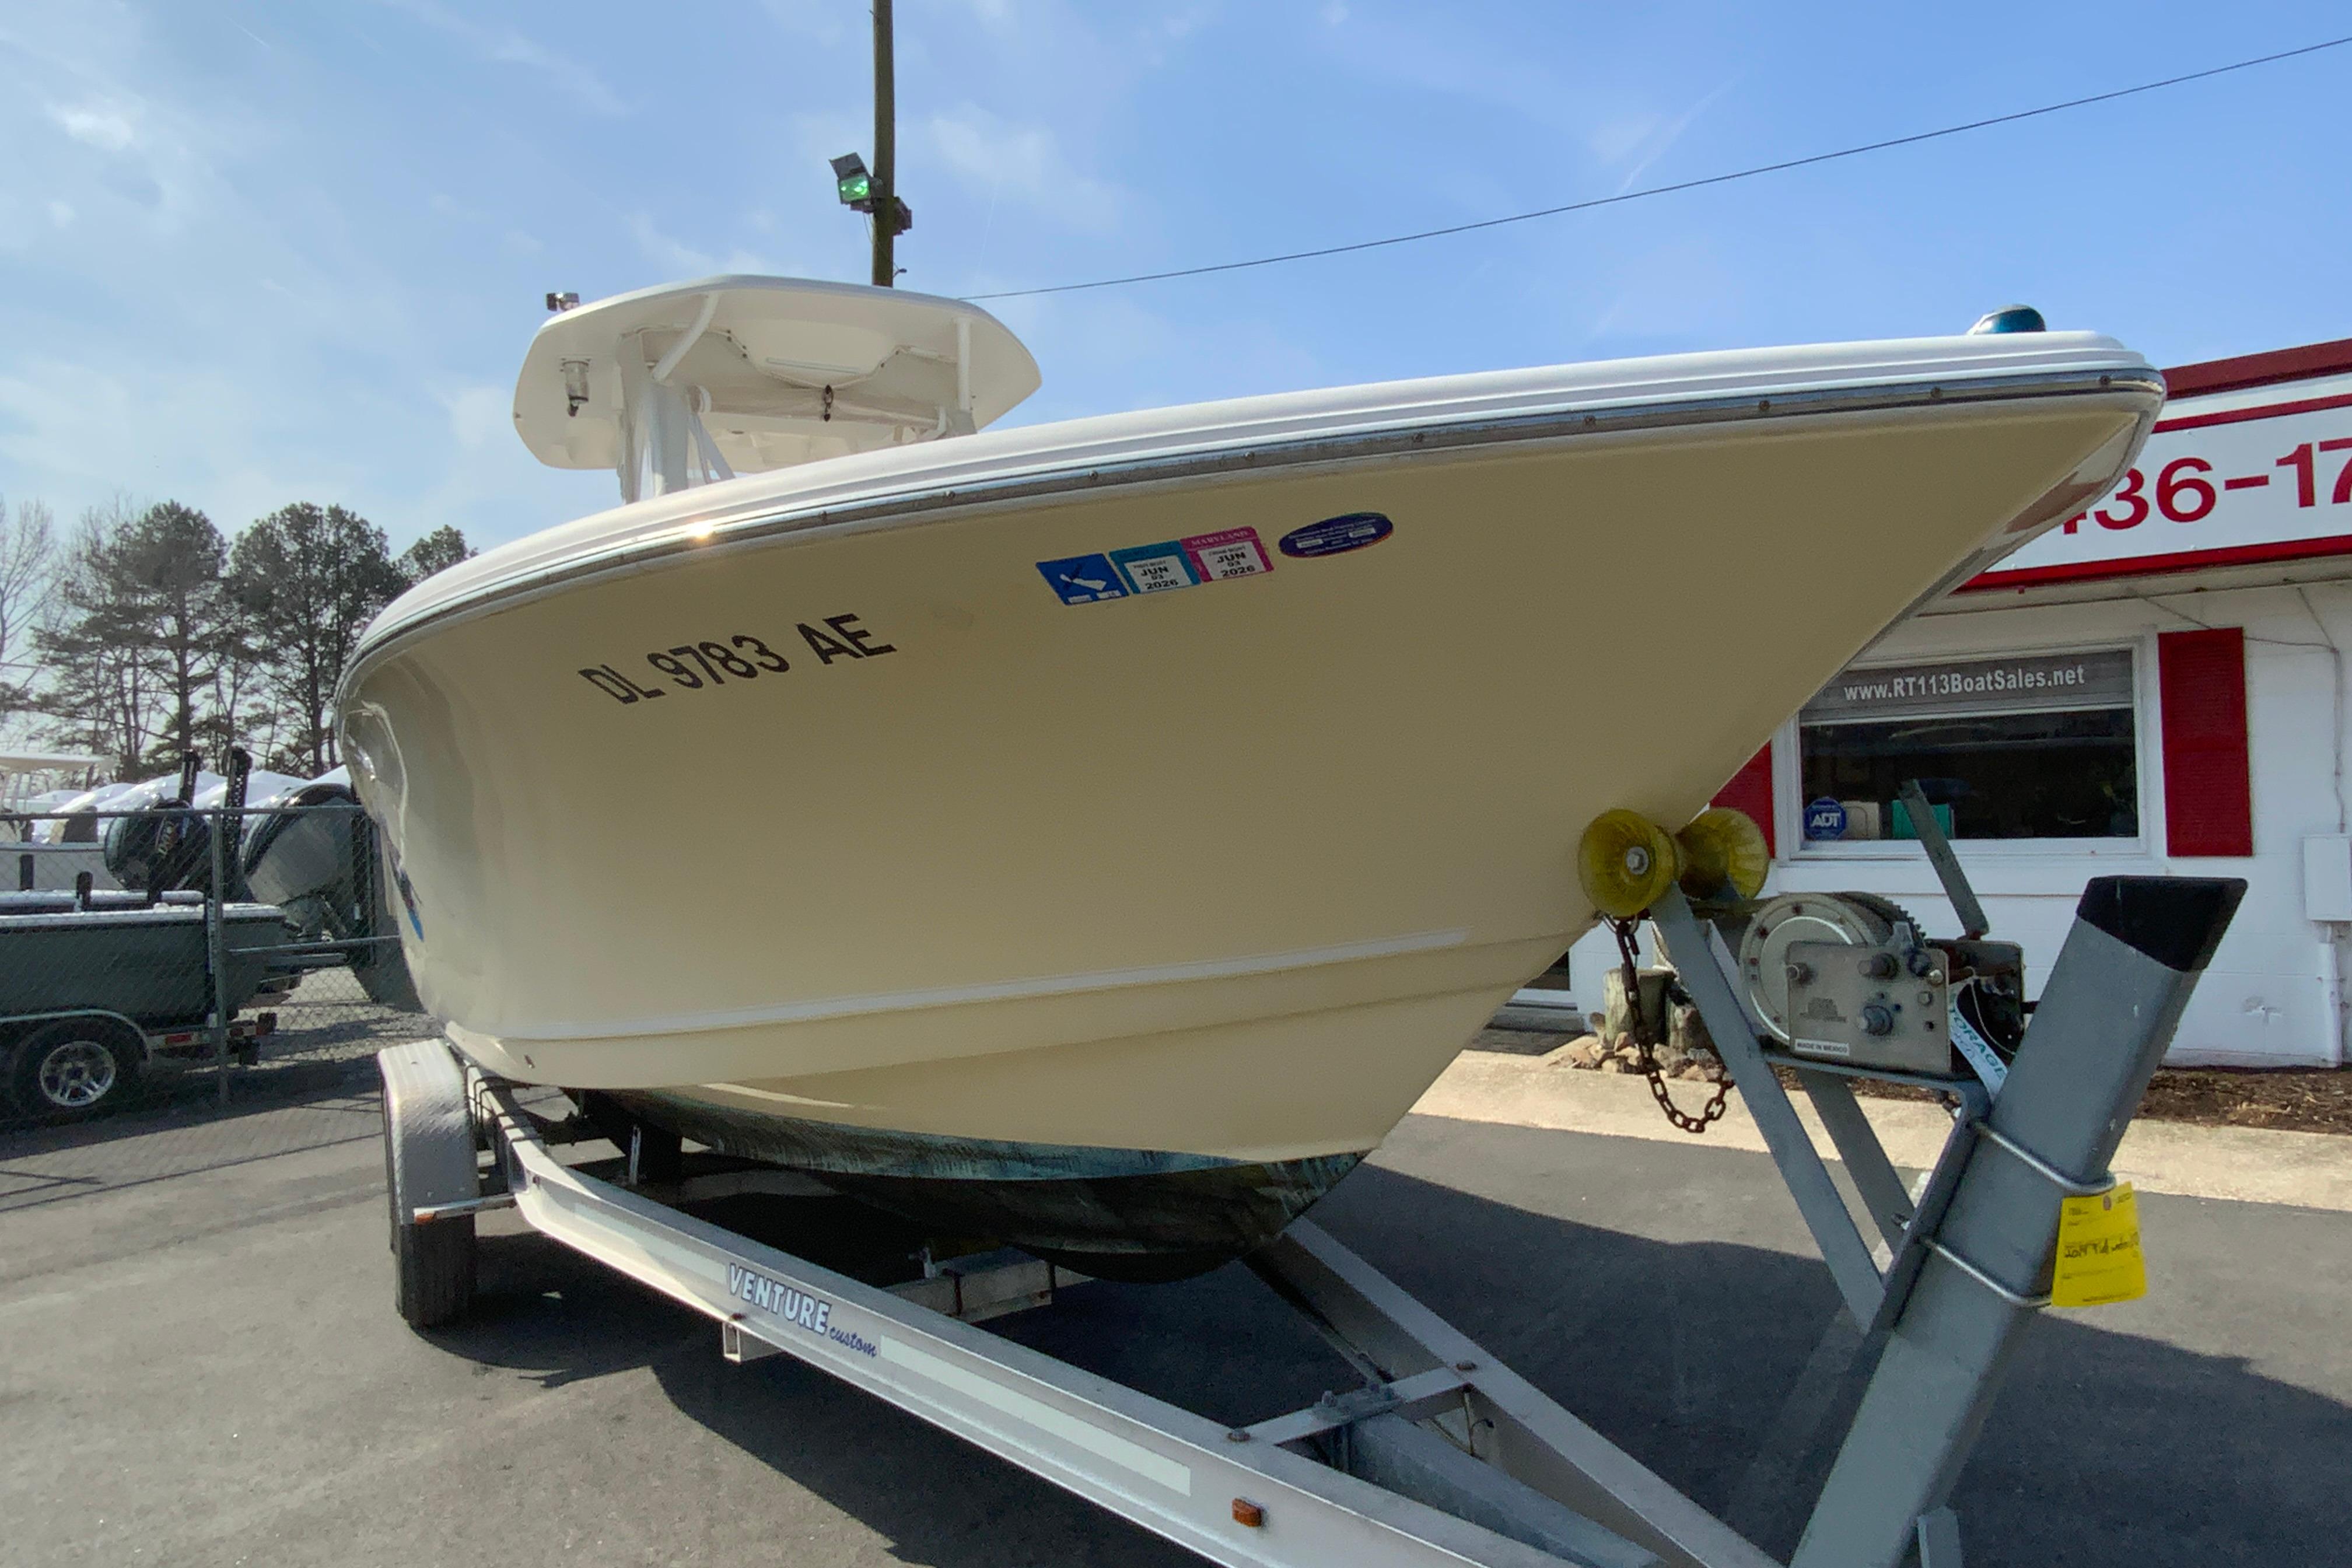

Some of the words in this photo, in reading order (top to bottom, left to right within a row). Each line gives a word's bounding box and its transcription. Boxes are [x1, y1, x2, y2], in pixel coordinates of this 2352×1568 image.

[2061, 438, 2352, 535] 36-17
[1191, 530, 1248, 545] MARYLAND
[1217, 551, 1246, 564] JUN
[1140, 566, 1169, 576] JUN
[1220, 565, 1255, 577] 2026
[1145, 579, 1178, 590] 2026
[578, 664, 666, 705] DL
[646, 635, 790, 689] 9783
[795, 613, 897, 664] AE
[1844, 664, 2085, 701] www.RT113BoatSales.net
[1810, 812, 1841, 828] ADT
[1823, 1045, 1848, 1054] MEXICO
[729, 1262, 832, 1335] VENTURE
[829, 1326, 878, 1359] custom
